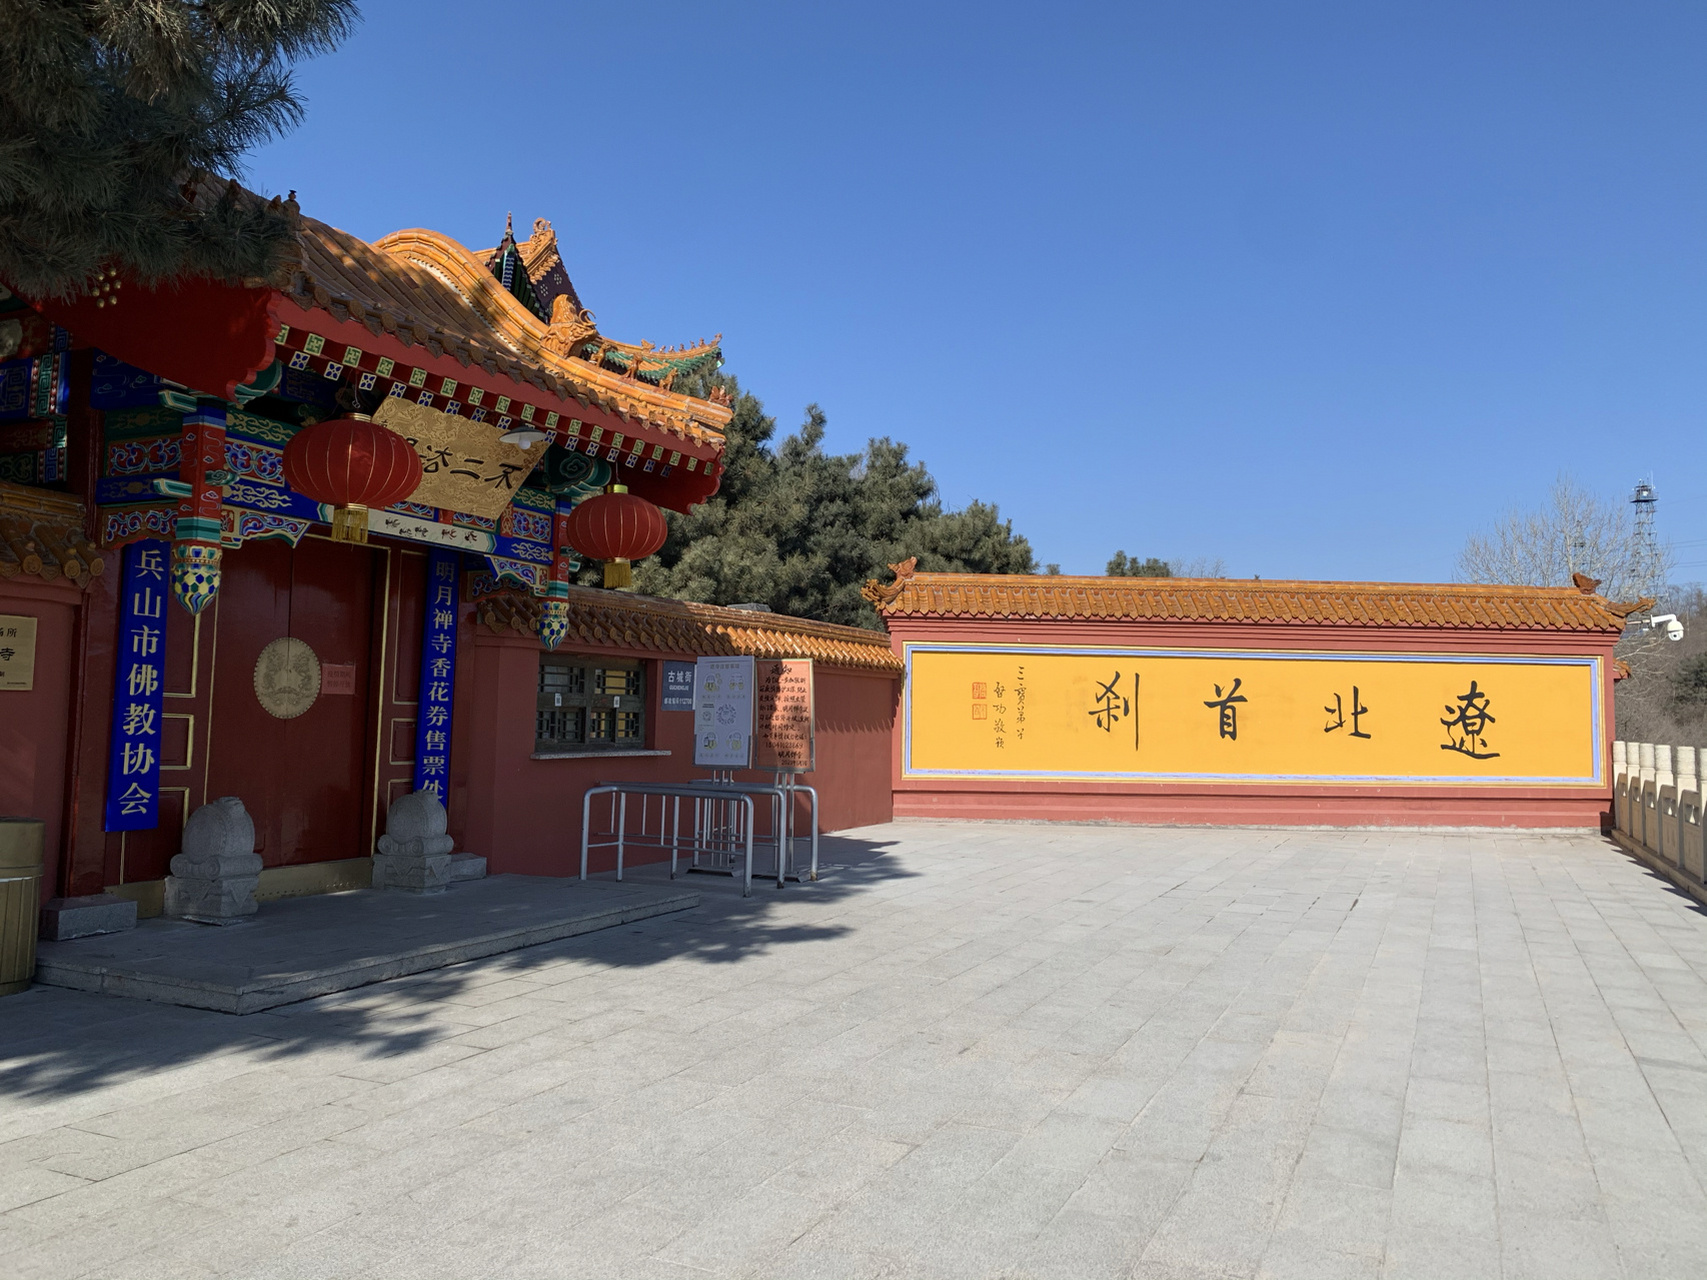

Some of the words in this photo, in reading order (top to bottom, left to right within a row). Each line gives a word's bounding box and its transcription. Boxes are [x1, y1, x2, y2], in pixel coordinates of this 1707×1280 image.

[406, 438, 524, 490] 不二法
[117, 537, 165, 816] 兵山市佛教协会
[422, 560, 454, 800] 明月禅寺香花券售票处
